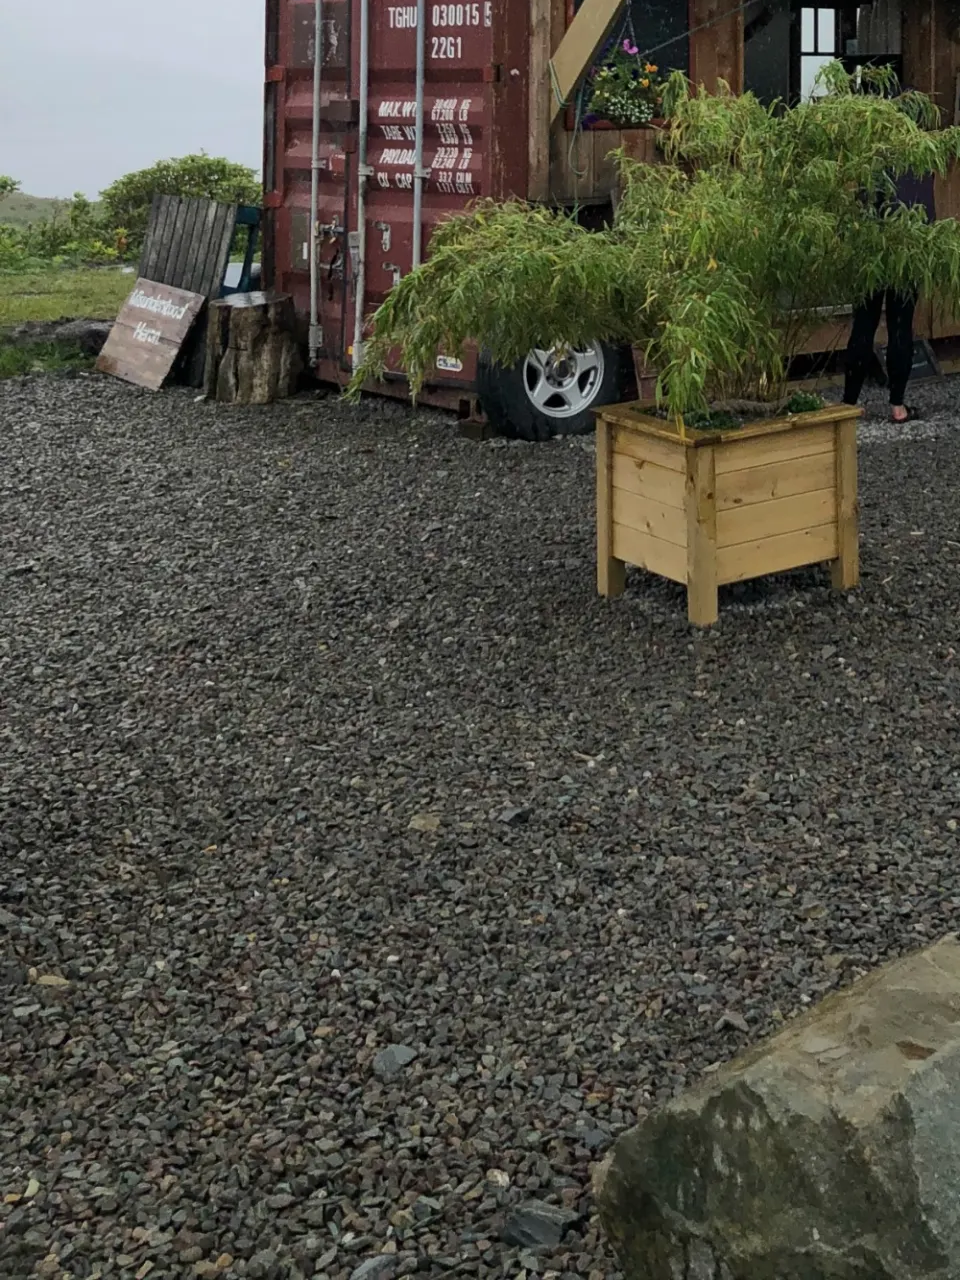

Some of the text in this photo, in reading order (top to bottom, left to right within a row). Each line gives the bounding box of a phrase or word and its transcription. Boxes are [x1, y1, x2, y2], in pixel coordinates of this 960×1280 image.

[388, 6, 418, 28] TGHU
[432, 3, 479, 27] 030015
[431, 37, 462, 59] 22G1
[458, 109, 468, 121] LB
[379, 125, 404, 140] TARE
[458, 158, 470, 170] LB
